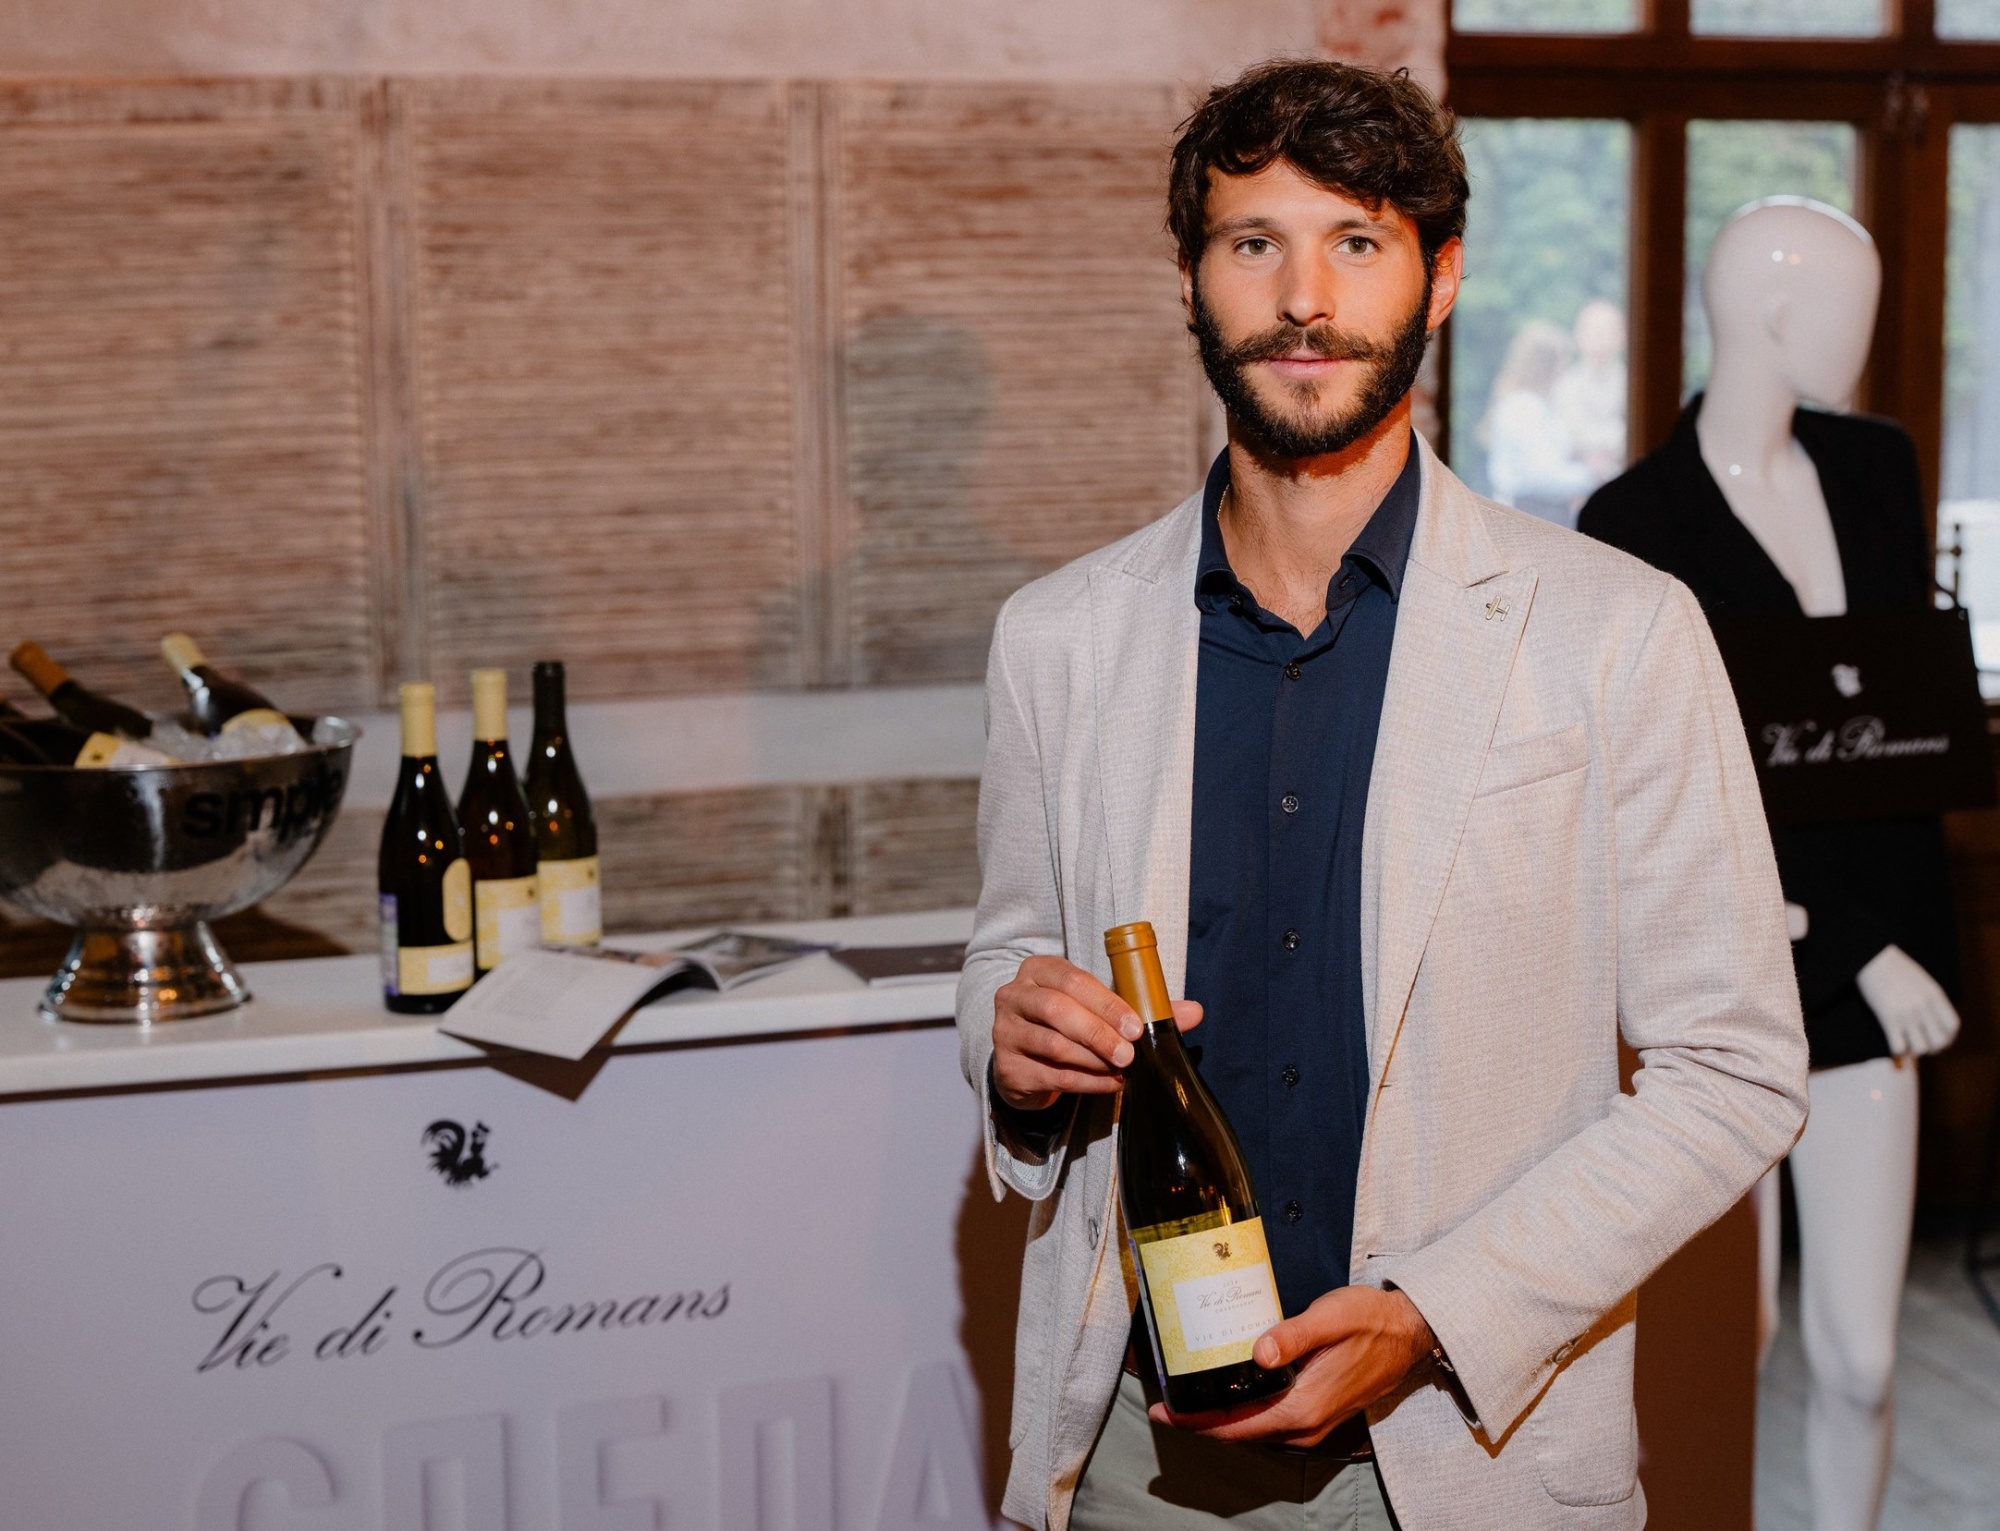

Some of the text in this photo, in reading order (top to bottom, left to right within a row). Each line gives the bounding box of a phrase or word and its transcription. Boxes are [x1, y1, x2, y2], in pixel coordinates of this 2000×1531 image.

[191, 1245, 732, 1373] Vie di Romans
